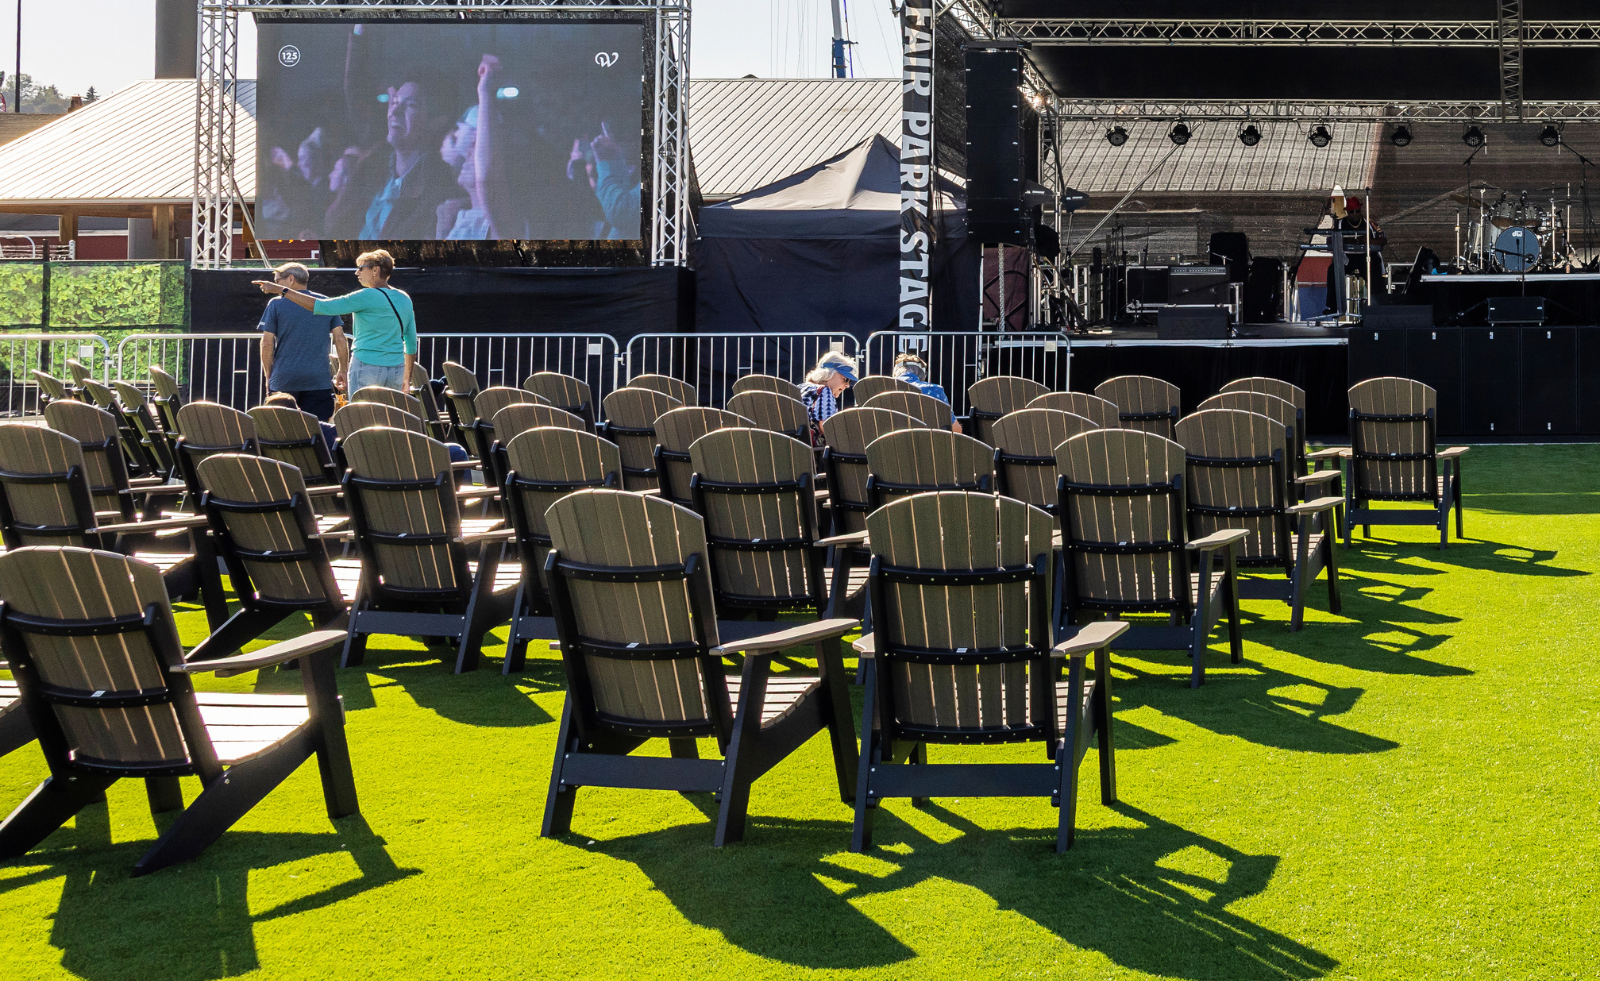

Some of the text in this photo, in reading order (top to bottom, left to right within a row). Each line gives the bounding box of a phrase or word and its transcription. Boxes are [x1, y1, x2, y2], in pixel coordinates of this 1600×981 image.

[281, 52, 298, 60] 125
[898, 5, 933, 353] FAIR PARK STAGE
